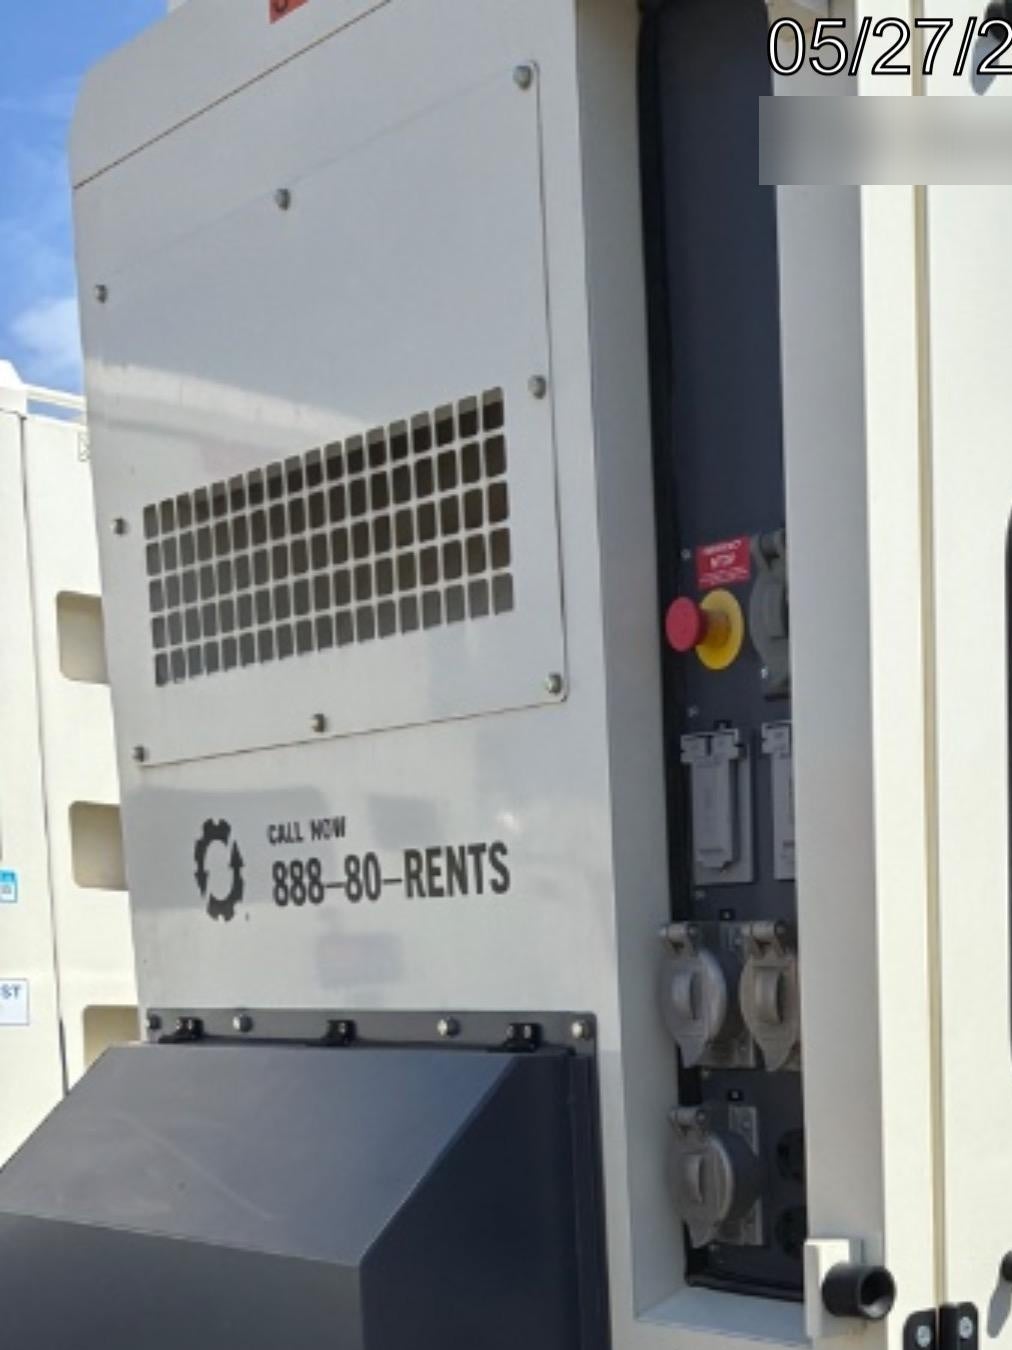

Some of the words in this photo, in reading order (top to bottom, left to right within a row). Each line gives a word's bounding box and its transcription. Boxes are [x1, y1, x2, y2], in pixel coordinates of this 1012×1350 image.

[267, 823, 304, 846] CALL
[310, 816, 346, 841] NOW
[272, 840, 511, 907] 888-80-RENTS
